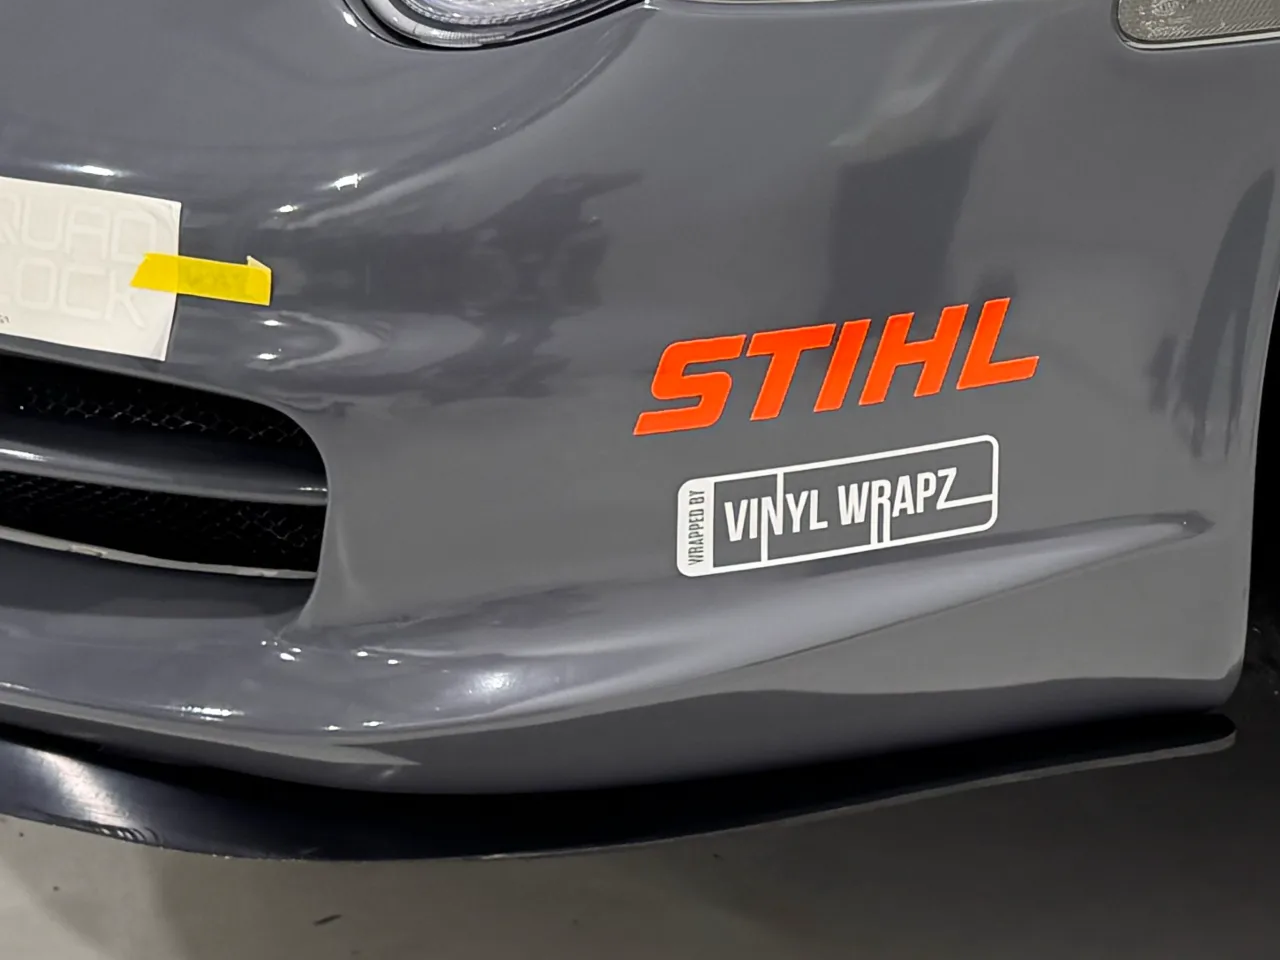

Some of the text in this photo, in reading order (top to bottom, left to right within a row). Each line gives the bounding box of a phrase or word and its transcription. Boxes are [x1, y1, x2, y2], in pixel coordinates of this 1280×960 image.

[0, 254, 147, 330] OCK
[632, 297, 1040, 436] STIHL
[687, 490, 705, 566] WRAPPED BY
[724, 466, 958, 545] VINYL WRAPZ
